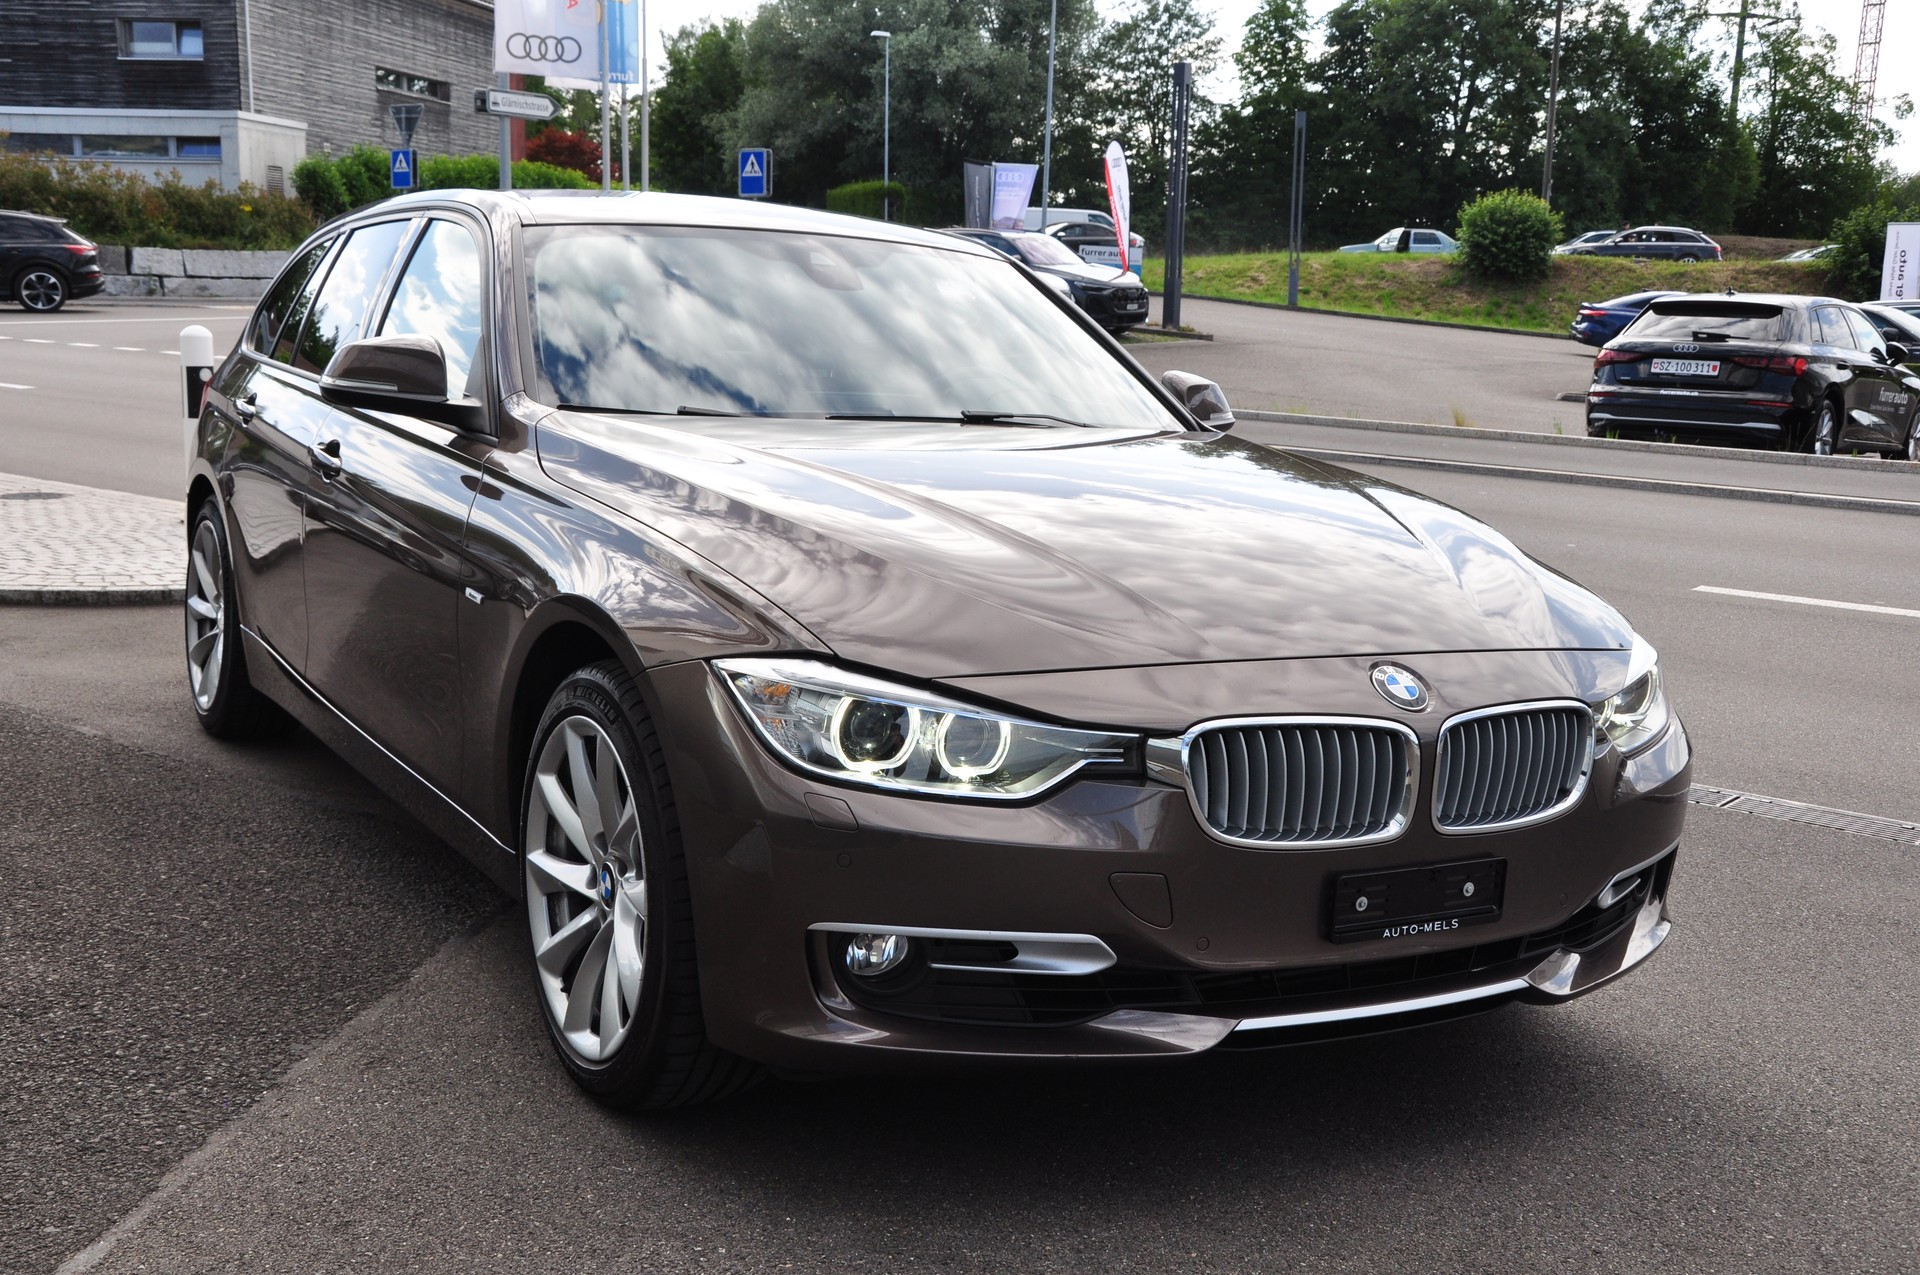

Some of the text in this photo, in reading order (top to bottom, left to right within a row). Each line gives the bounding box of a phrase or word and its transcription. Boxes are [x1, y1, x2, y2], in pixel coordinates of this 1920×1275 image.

[1081, 248, 1107, 257] furrer
[1375, 666, 1414, 680] BMW
[574, 686, 617, 721] MICHELIN
[1383, 919, 1459, 938] AUTO-MELS
